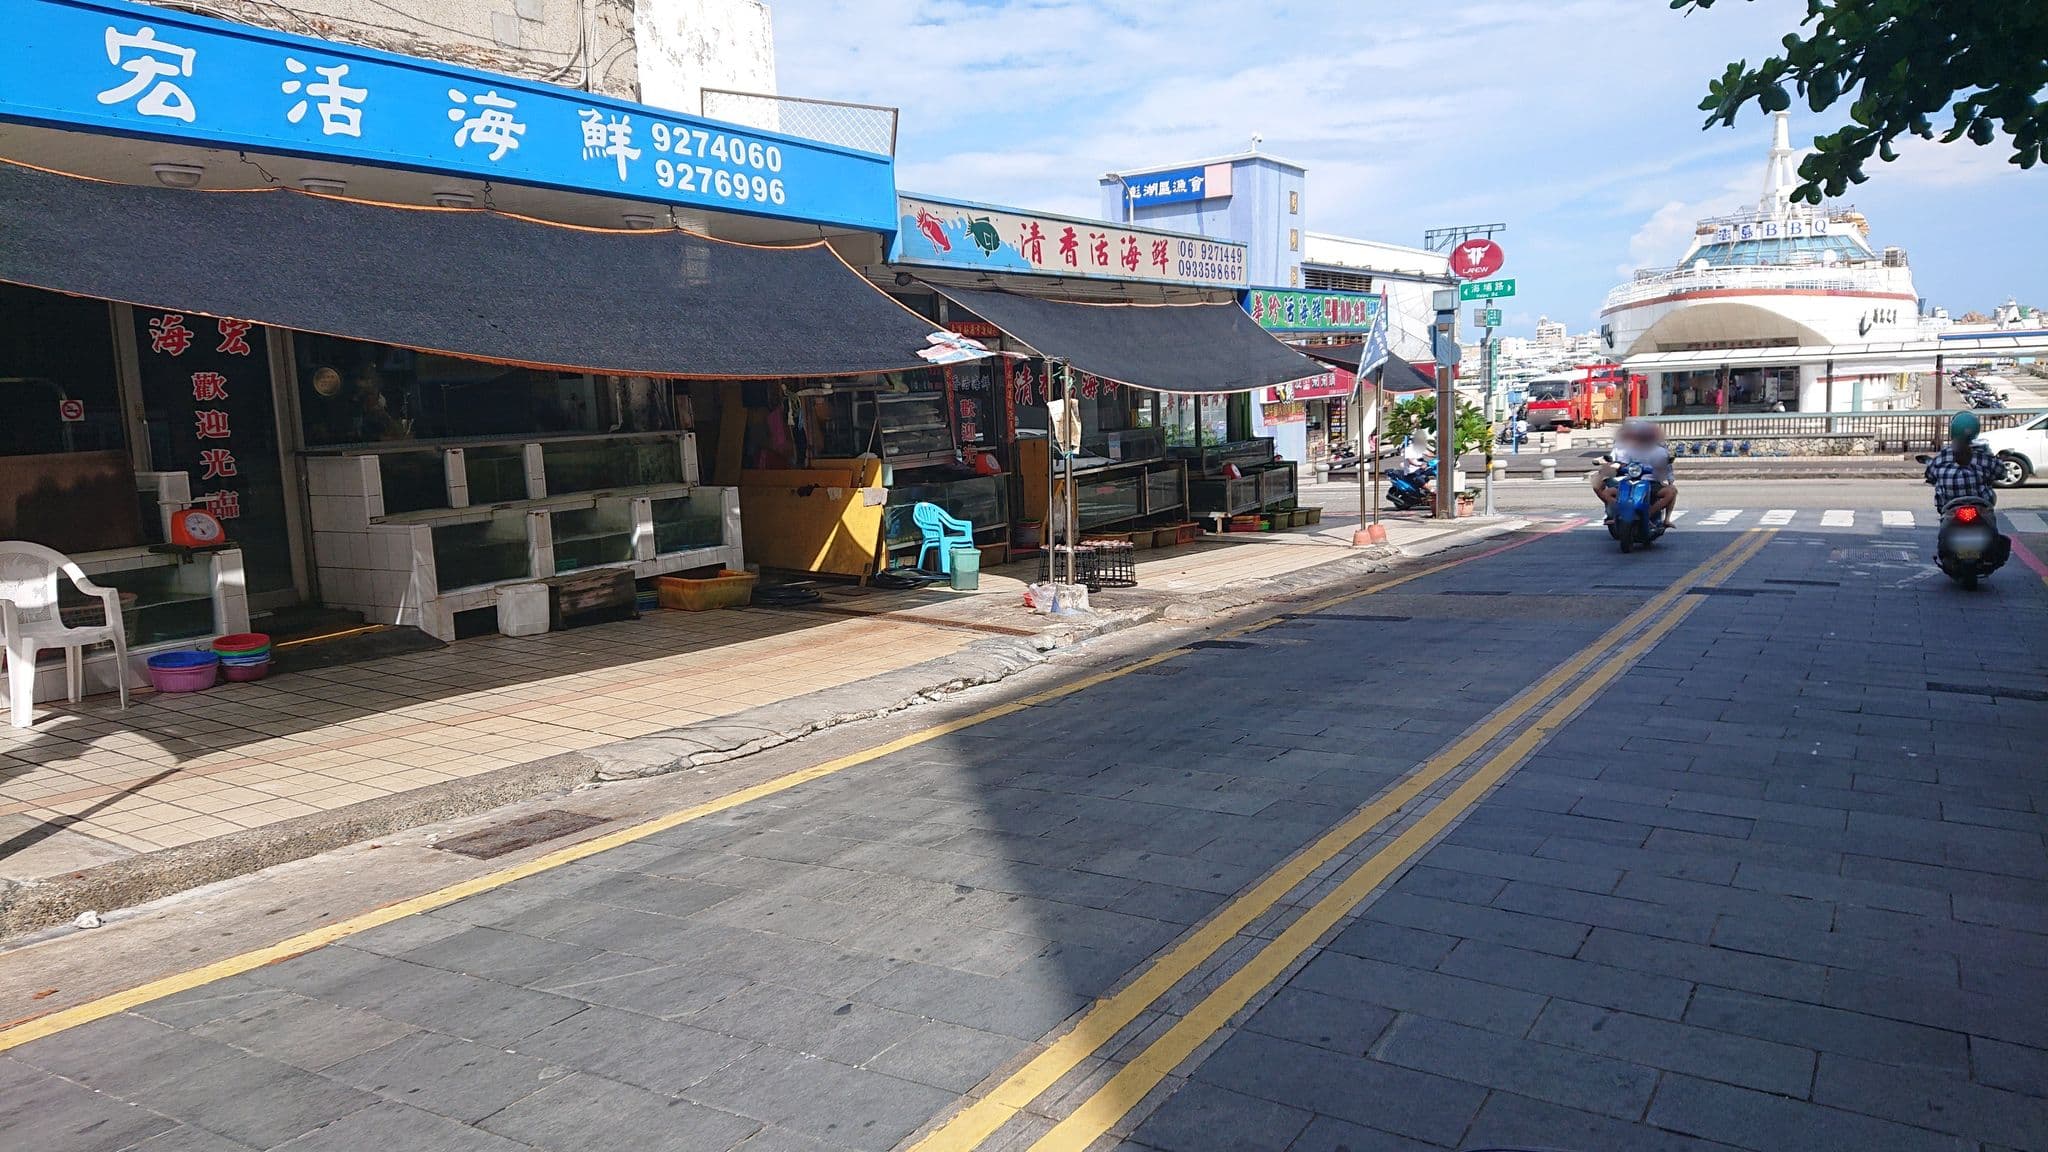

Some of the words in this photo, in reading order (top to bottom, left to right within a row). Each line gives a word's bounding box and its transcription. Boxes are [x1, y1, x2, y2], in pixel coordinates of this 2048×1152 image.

[97, 26, 641, 182] 宏活海鮮
[651, 123, 783, 173] 9274060
[655, 159, 786, 205] 9276996
[1020, 221, 1169, 275] 清香活海鮮
[1177, 240, 1197, 259] (06)
[1201, 243, 1242, 264] 9271449
[1178, 259, 1242, 281] 0933598667
